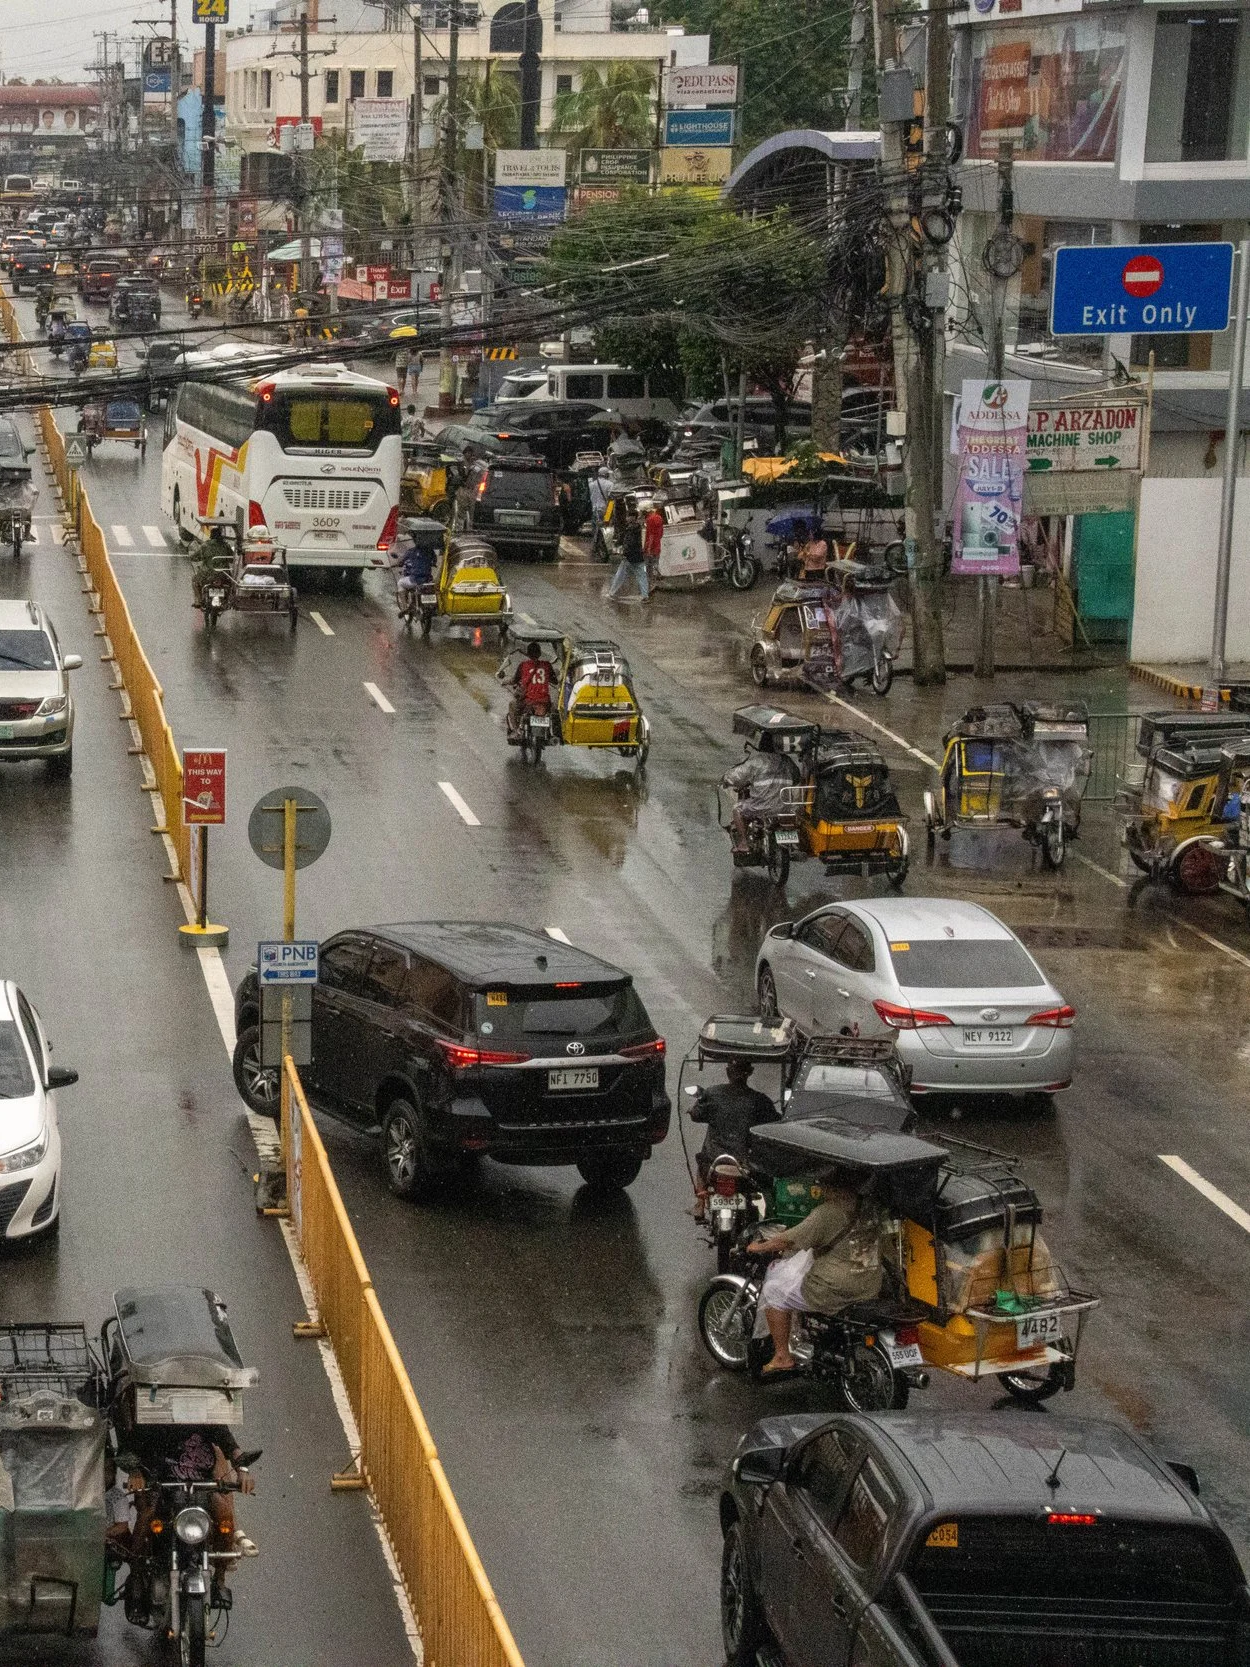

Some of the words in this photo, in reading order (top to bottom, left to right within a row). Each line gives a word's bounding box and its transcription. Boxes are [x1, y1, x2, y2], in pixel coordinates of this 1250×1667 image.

[684, 75, 735, 87] EDUPASS
[679, 122, 729, 130] LIGHTHOUSE
[502, 164, 528, 172] TRAVEL
[581, 190, 619, 199] PENSION
[1082, 304, 1127, 326] Exit
[1142, 302, 1197, 328] Only
[968, 411, 1021, 420] ADDESSA
[1054, 408, 1137, 431] ARZADON
[1027, 433, 1080, 447] MACHINE
[1087, 431, 1122, 446] SHOP
[962, 445, 1021, 454] ADDESSA
[969, 456, 1012, 480] SALE
[312, 517, 341, 527] 3609
[282, 946, 316, 961] PNB
[964, 1031, 983, 1042] NEY
[988, 1031, 1012, 1042] 9122
[550, 1074, 568, 1086] NFI
[574, 1072, 597, 1084] 7750
